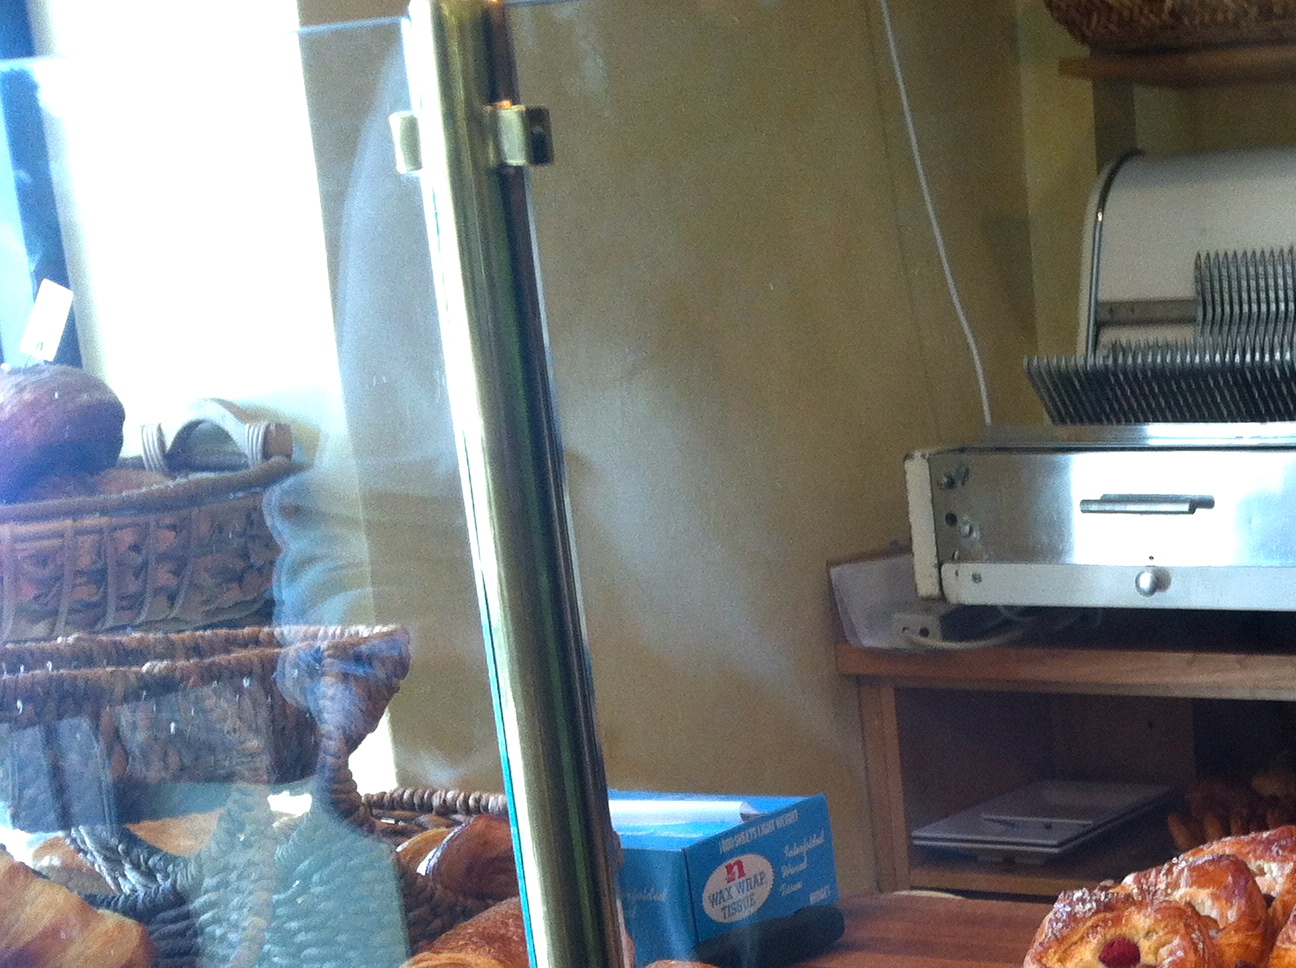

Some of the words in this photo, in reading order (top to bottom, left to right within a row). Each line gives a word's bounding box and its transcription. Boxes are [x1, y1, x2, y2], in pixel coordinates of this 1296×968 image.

[708, 888, 734, 909] WAX
[735, 872, 766, 898] WRAP
[721, 897, 757, 920] TISSUE
